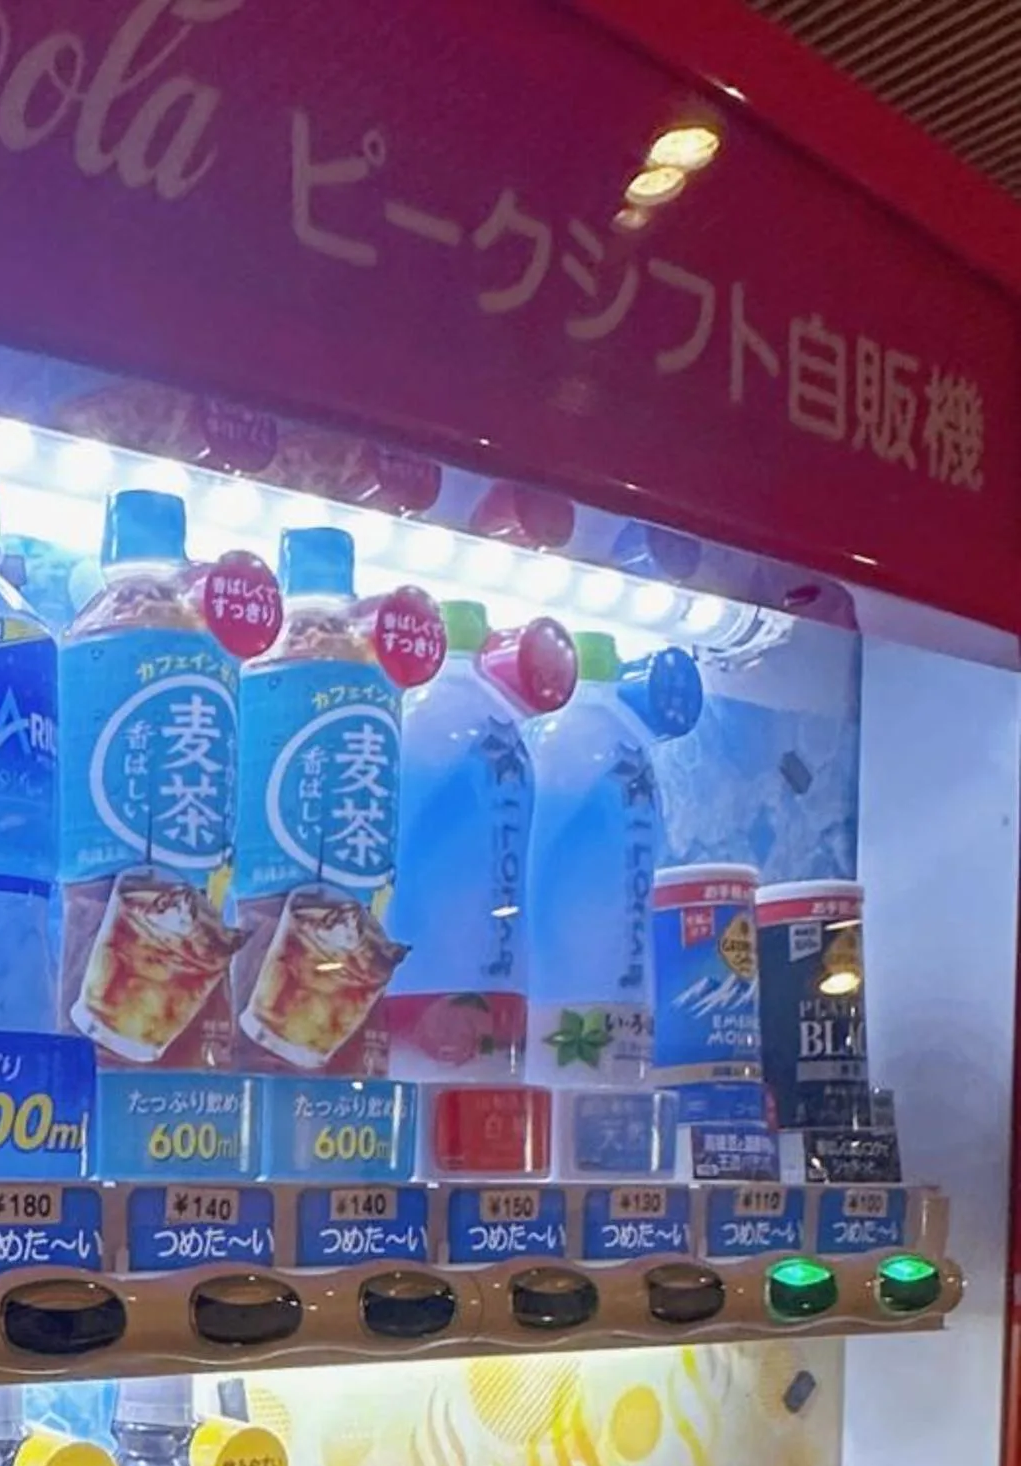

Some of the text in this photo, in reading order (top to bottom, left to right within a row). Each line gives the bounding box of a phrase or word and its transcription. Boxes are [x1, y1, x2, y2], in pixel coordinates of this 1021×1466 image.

[291, 107, 983, 488] ピークシフト自販機
[212, 596, 276, 627] すっきり
[381, 632, 441, 661] すっきり
[157, 693, 224, 850] 麦茶
[325, 723, 390, 868] 麦茶
[173, 1194, 232, 1221] ¥140
[335, 1192, 387, 1216] ¥140
